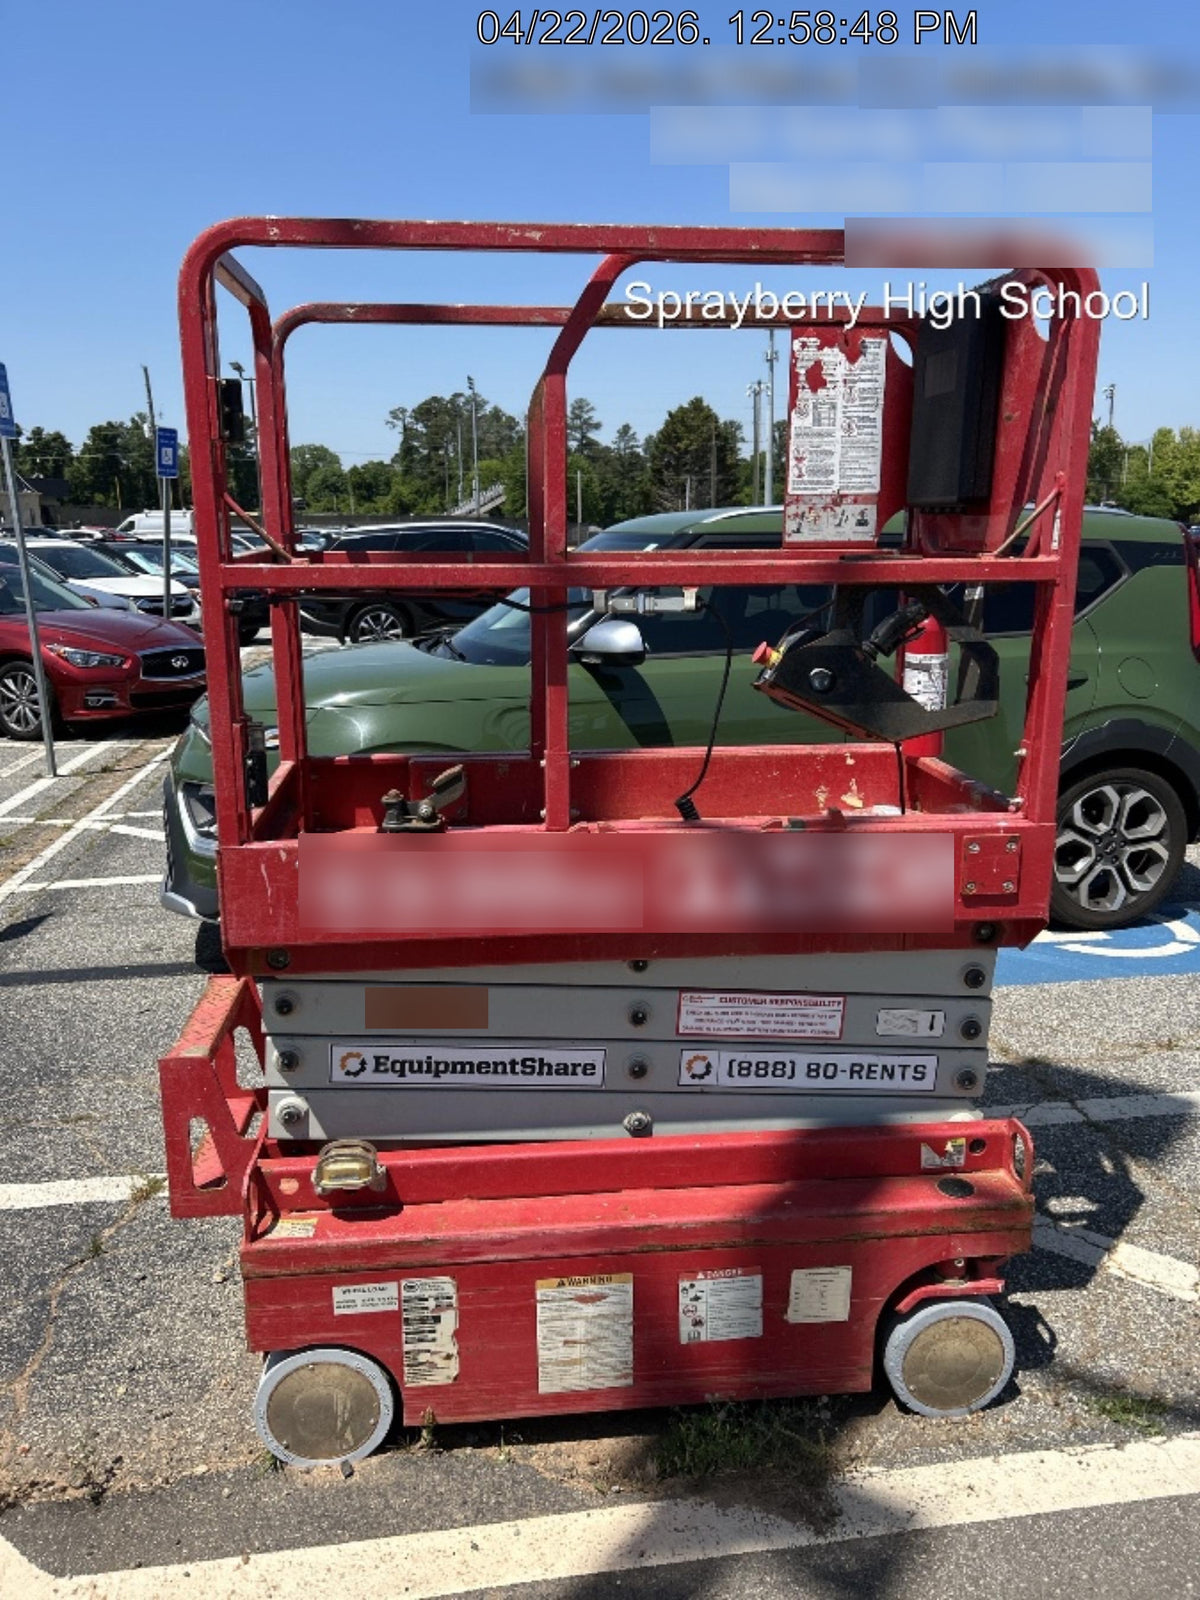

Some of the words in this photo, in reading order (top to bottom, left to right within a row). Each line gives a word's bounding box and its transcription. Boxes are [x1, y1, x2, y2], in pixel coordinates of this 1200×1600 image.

[372, 1055, 596, 1078] EquipmentShare
[727, 1059, 796, 1080] (888)
[806, 1062, 927, 1081] 80-RENTS
